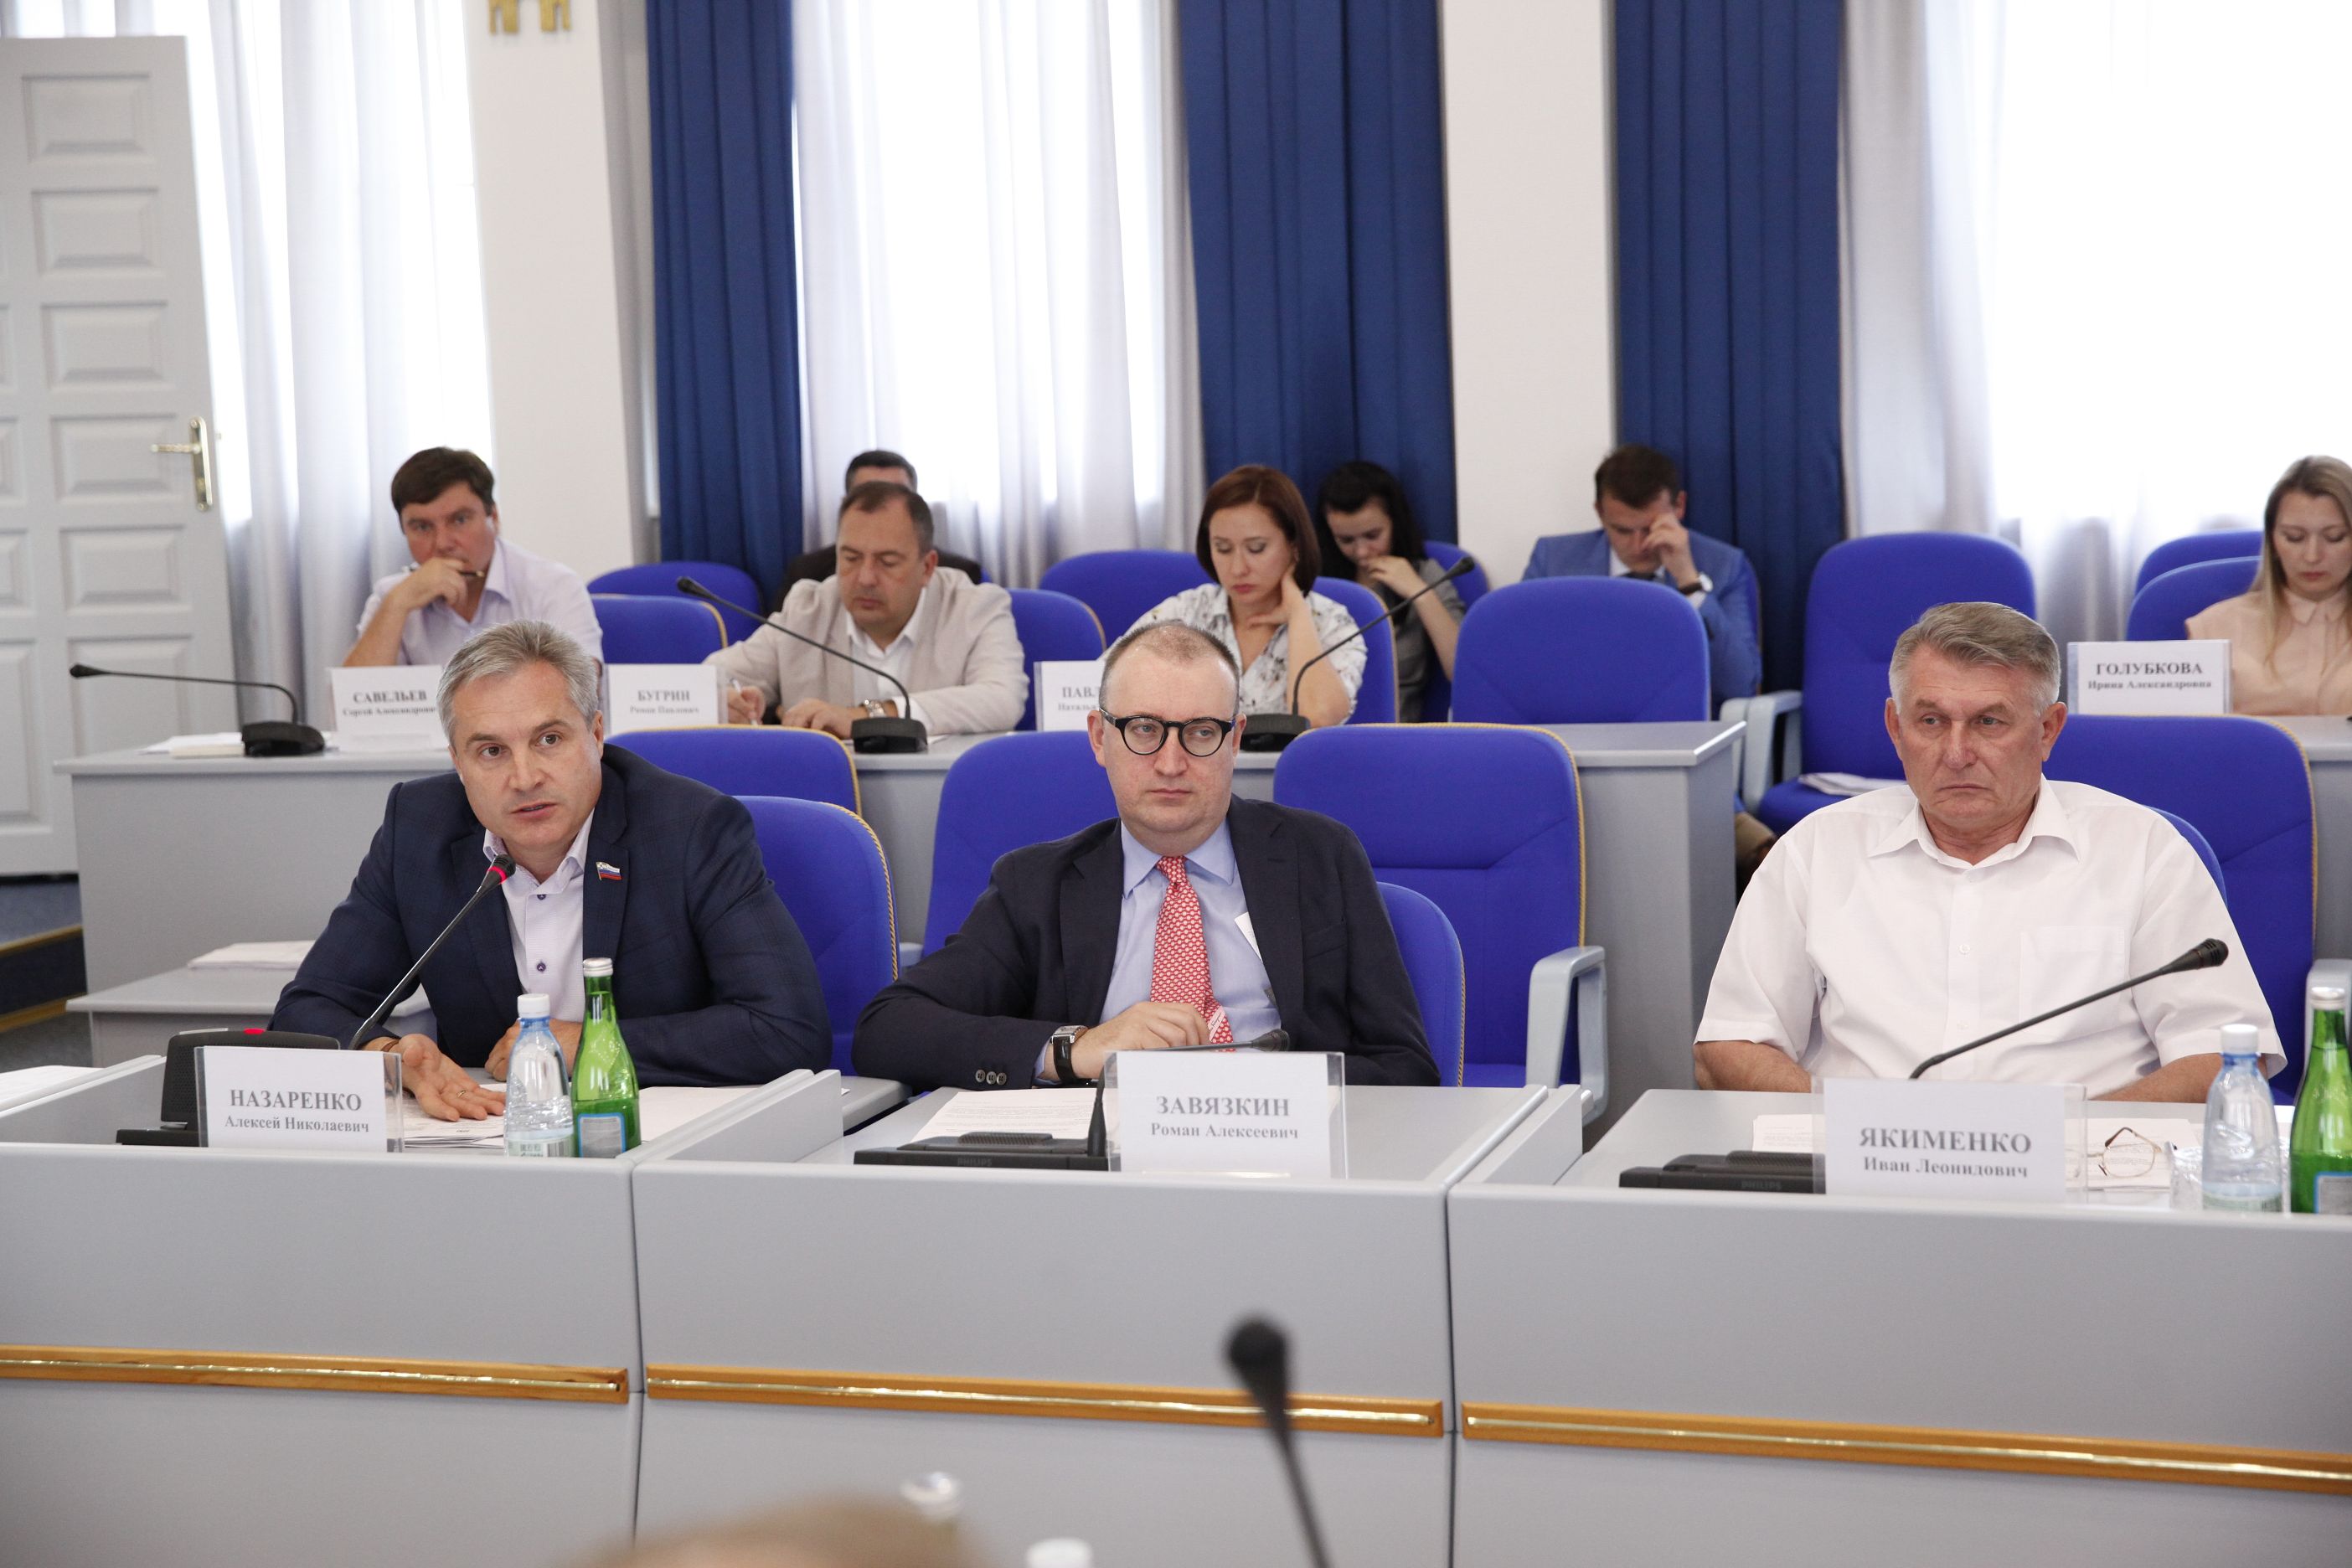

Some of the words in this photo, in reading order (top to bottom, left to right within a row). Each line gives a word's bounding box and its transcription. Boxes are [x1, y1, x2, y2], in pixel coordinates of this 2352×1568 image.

[2096, 662, 2203, 675] ГОЛУБКОВА
[2087, 679, 2124, 691] Ирина
[2127, 679, 2212, 691] Александровна
[353, 689, 428, 704] САВЕЛЬЕВ
[637, 689, 690, 702] БУГРИН
[342, 707, 374, 718] Сергей
[230, 1089, 363, 1112] НАЗАРЕНКО
[1156, 1095, 1291, 1117] ЗАВЯЗКИН
[224, 1115, 281, 1130] Алексей
[285, 1117, 370, 1133] Николаевич
[1150, 1122, 1200, 1137] Роман
[1204, 1122, 1299, 1140] Алексеевич
[1859, 1127, 2033, 1155] ЯКИМЕНКО
[1863, 1156, 1910, 1174] Иван
[1914, 1157, 2030, 1180] Леонидович
